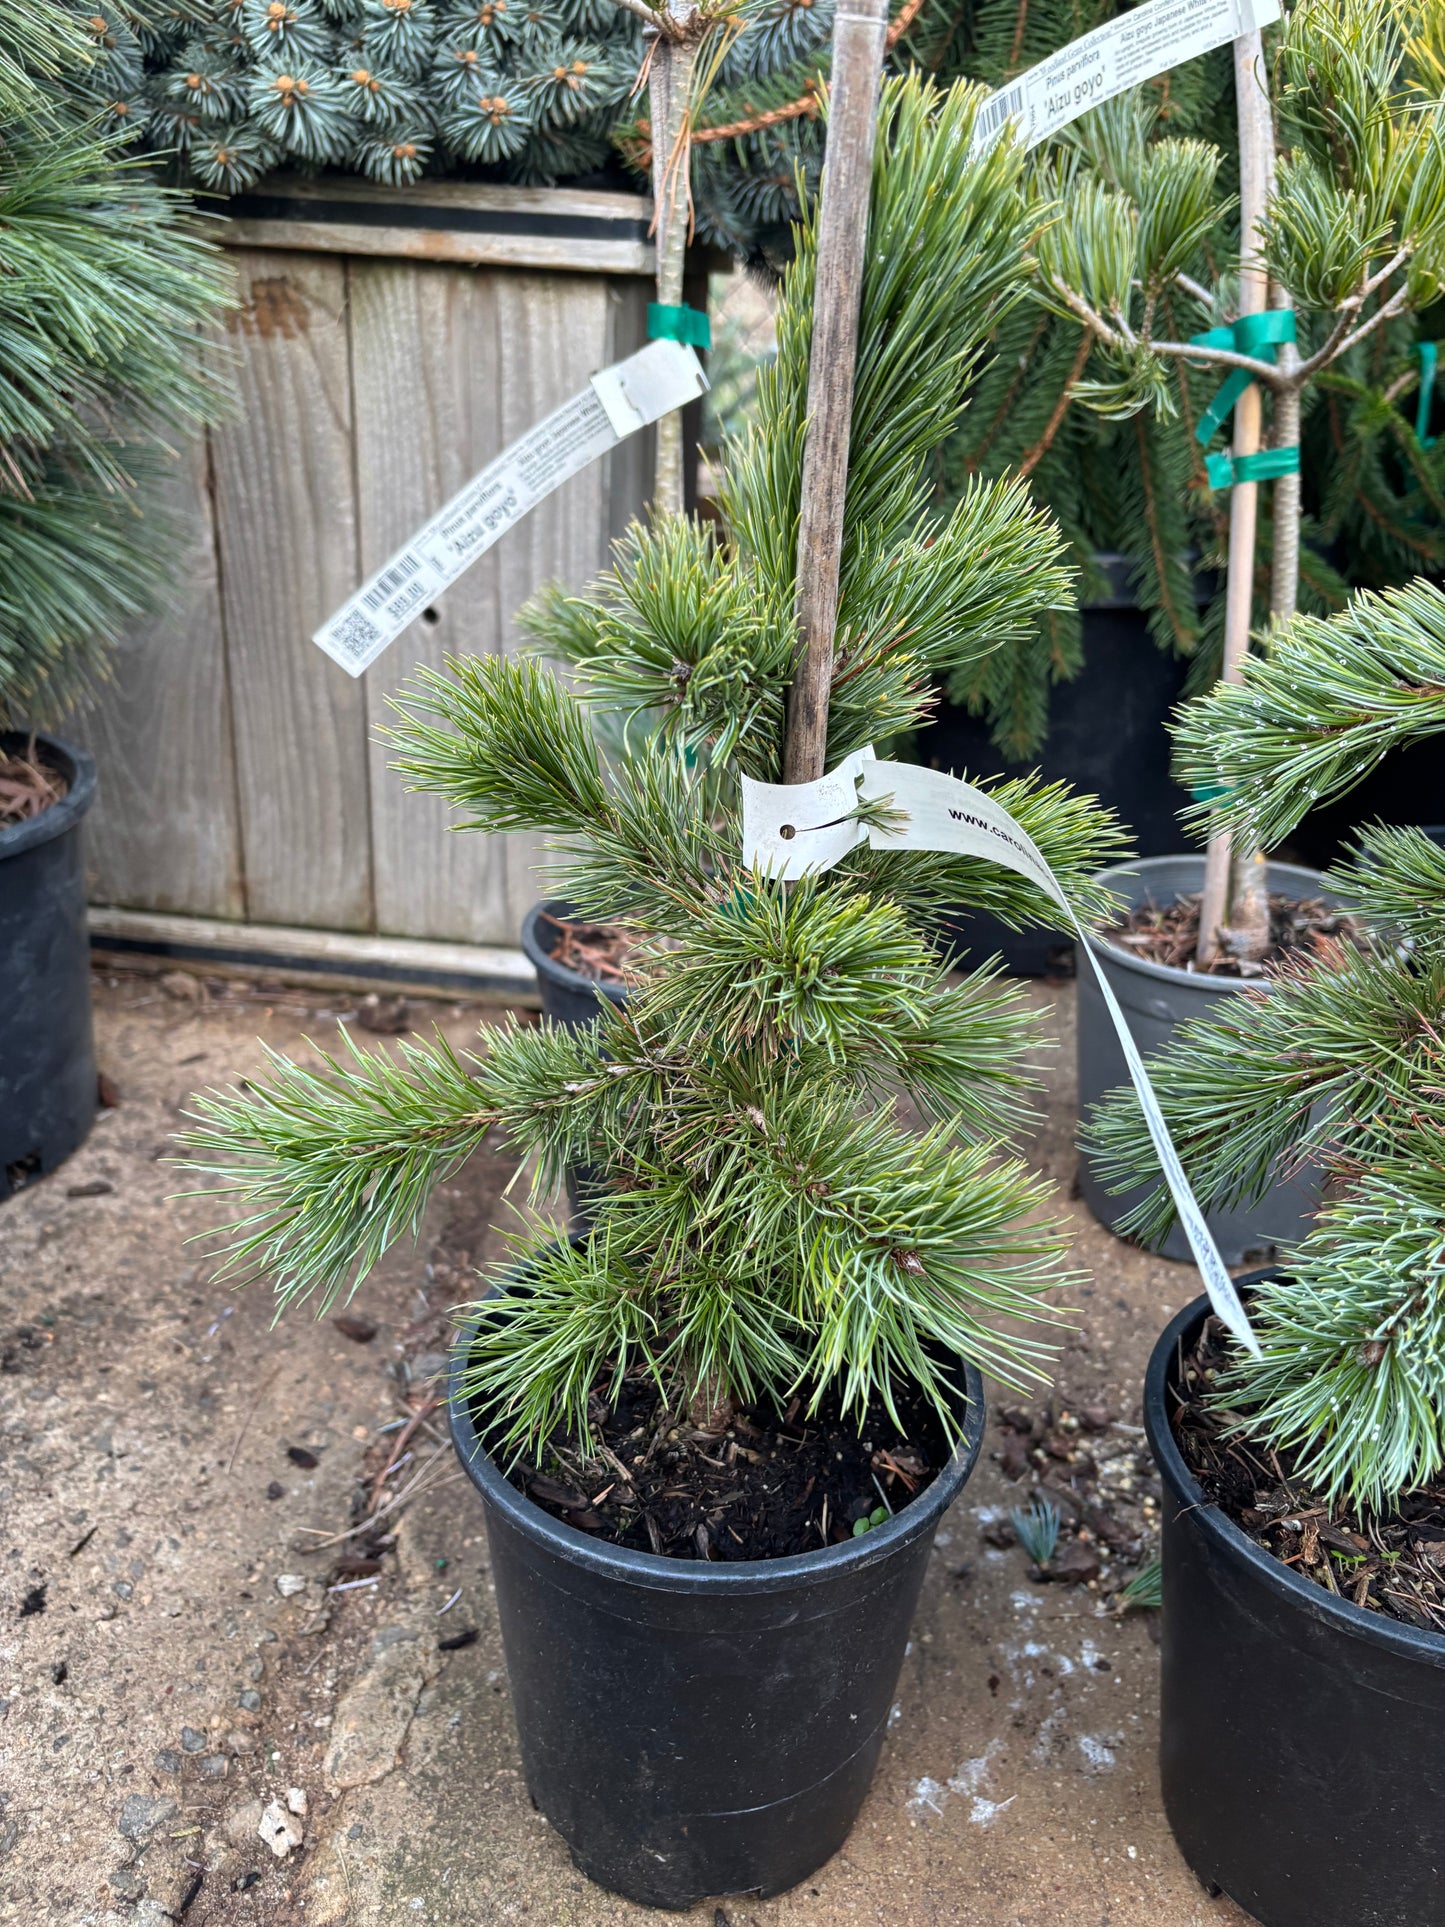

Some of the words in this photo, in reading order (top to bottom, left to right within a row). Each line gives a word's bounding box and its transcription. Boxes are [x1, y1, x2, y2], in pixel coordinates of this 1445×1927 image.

[1154, 6, 1187, 28] Japanese
[1045, 69, 1066, 90] Pinus
[1066, 49, 1100, 81] parviflora
[1044, 90, 1071, 119] 'Aizu
[1074, 64, 1106, 105] goyo'
[483, 486, 518, 531] goyo'
